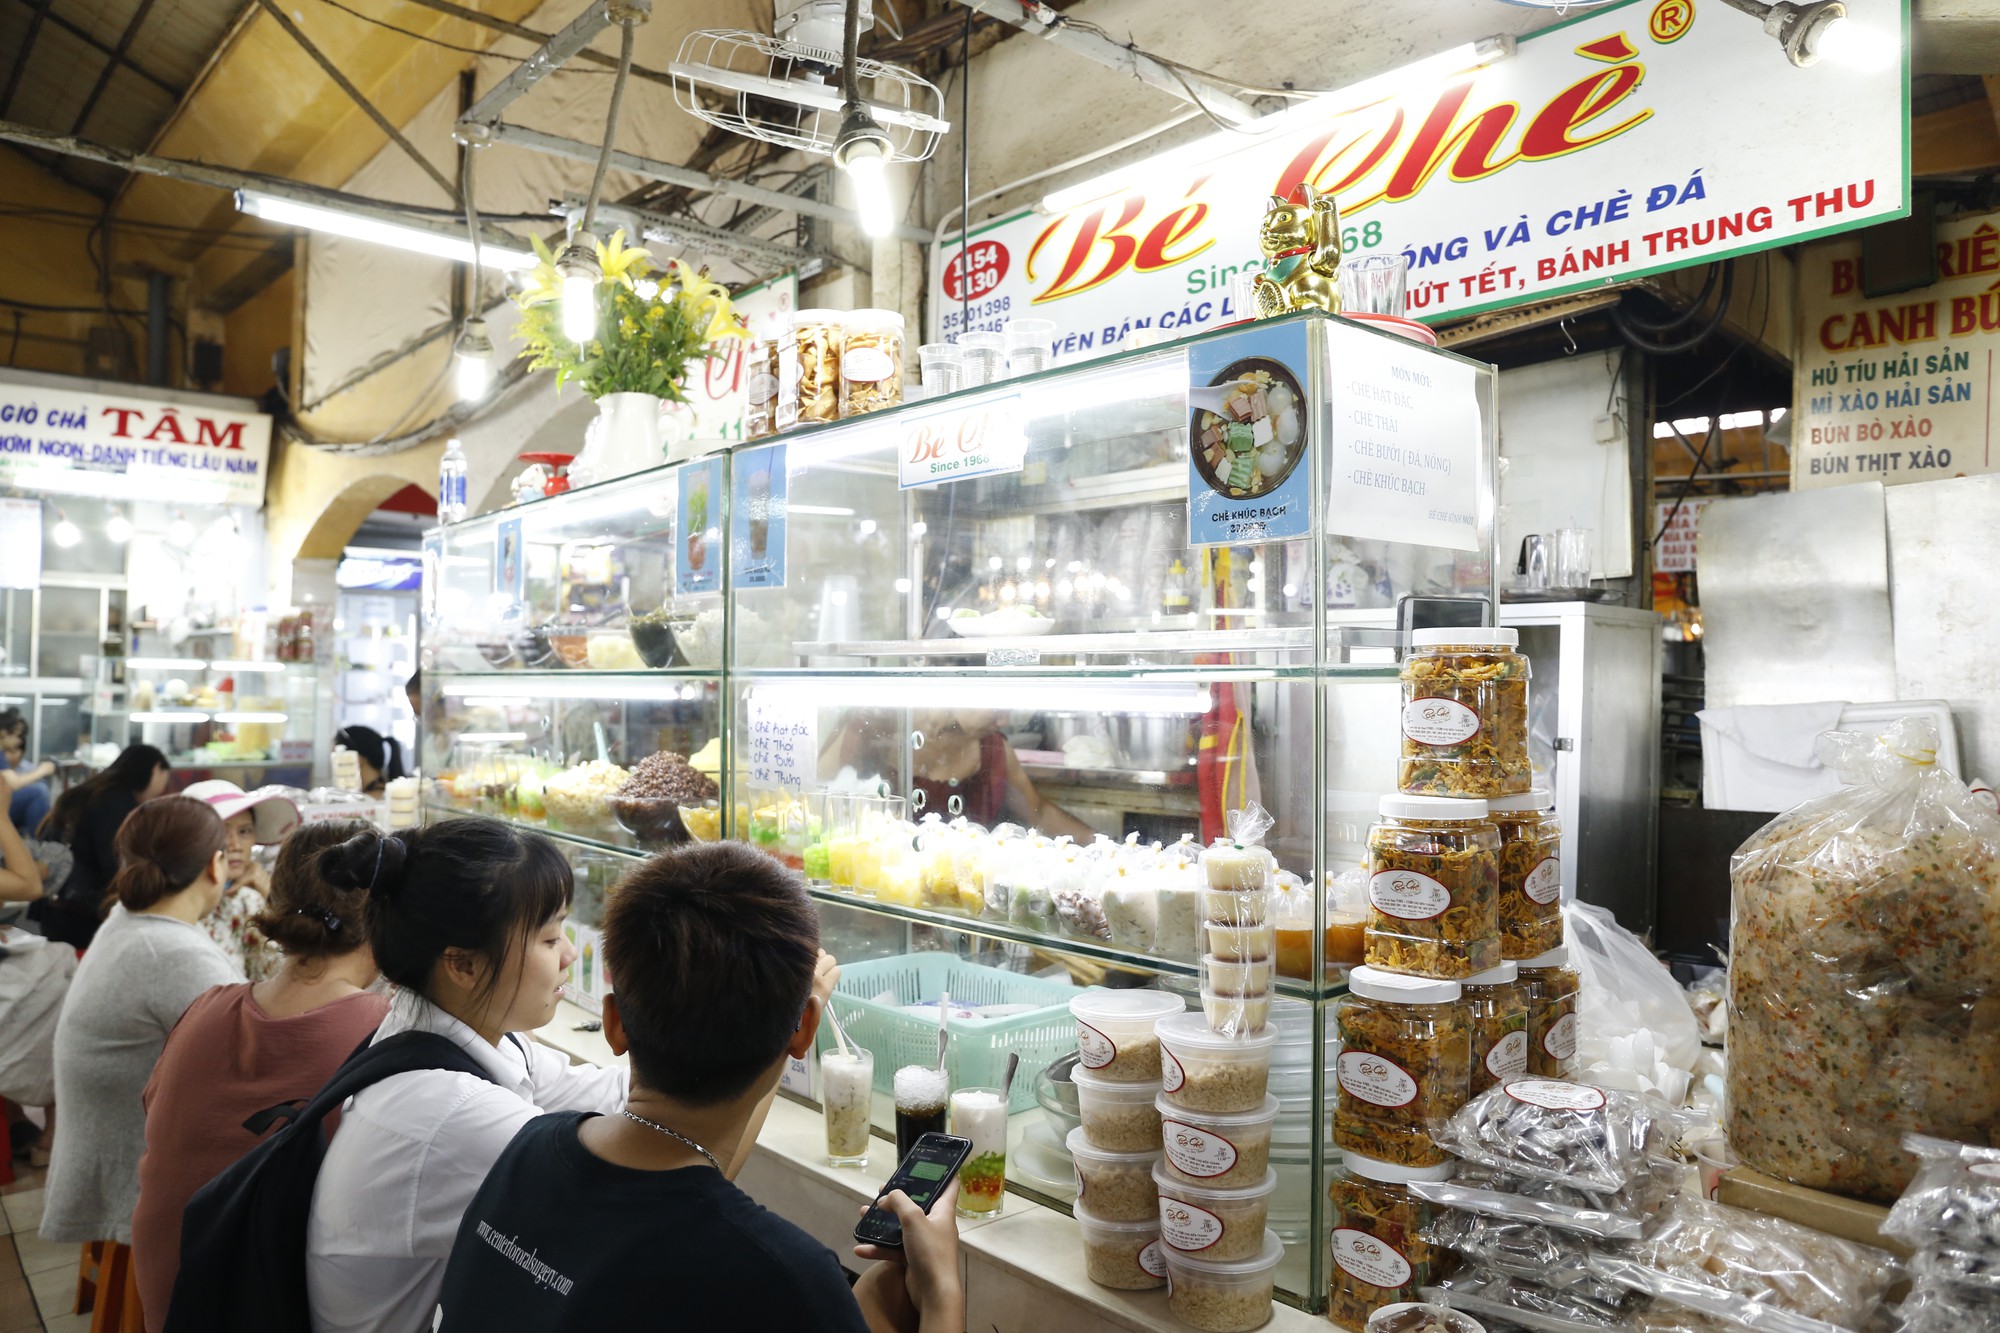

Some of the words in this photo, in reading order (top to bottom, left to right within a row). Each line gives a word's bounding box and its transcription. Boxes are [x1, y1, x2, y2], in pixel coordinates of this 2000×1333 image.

[1025, 174, 1216, 305] Bé
[1158, 301, 1213, 333] CÁC
[1401, 236, 1468, 271] ÓNG
[1484, 214, 1531, 251] VÀ
[1546, 188, 1633, 236] CHÈ
[1646, 167, 1706, 213] ĐÁ
[1406, 280, 1449, 311] ỨT
[1459, 261, 1525, 297] TẾT,
[1537, 239, 1630, 282] BÁNH
[1642, 206, 1773, 257] TRUNG
[1787, 178, 1874, 223] THU
[1937, 222, 2000, 278] RIÊ
[953, 244, 998, 277] 1154
[1186, 256, 1270, 295] Sinc
[953, 267, 998, 300] 1130
[1820, 301, 1937, 351] CANH
[1391, 365, 1411, 382] MÓN
[1812, 360, 1838, 387] HỦ
[1845, 359, 1877, 383] TÍU
[1883, 351, 1918, 379] HẢI
[1925, 346, 1969, 375] SẢN
[1351, 379, 1372, 399] CHÈ
[1811, 393, 1832, 415] MÌ
[1839, 388, 1879, 412] XÀO
[1885, 381, 1921, 408] HẢI
[1927, 377, 1971, 405] SẢN
[1, 400, 39, 425] GIÒ
[46, 405, 88, 430] CHẢ
[102, 406, 248, 451] TÂM
[1353, 409, 1374, 428] CHÈ
[1375, 413, 1399, 433] THÁI
[1811, 422, 1850, 445] BÚN
[1856, 417, 1883, 442] BÒ
[1889, 414, 1933, 440] XÀO
[1354, 438, 1375, 457] CHÈ
[1376, 443, 1401, 462] BƯỞI
[1810, 452, 1849, 475] BÚN
[1856, 452, 1902, 476] THỊT
[1908, 445, 1952, 470] XÀO
[930, 460, 960, 474] Since
[1353, 467, 1373, 487] CHÈ
[1374, 473, 1400, 492] KHÚC
[1401, 478, 1426, 496] BẠCH
[1211, 509, 1230, 522] CHÈ
[1231, 507, 1257, 520] KHÚC
[1259, 506, 1287, 519] BẠCH
[476, 1220, 574, 1296] www.centerfororalsurgery.com
